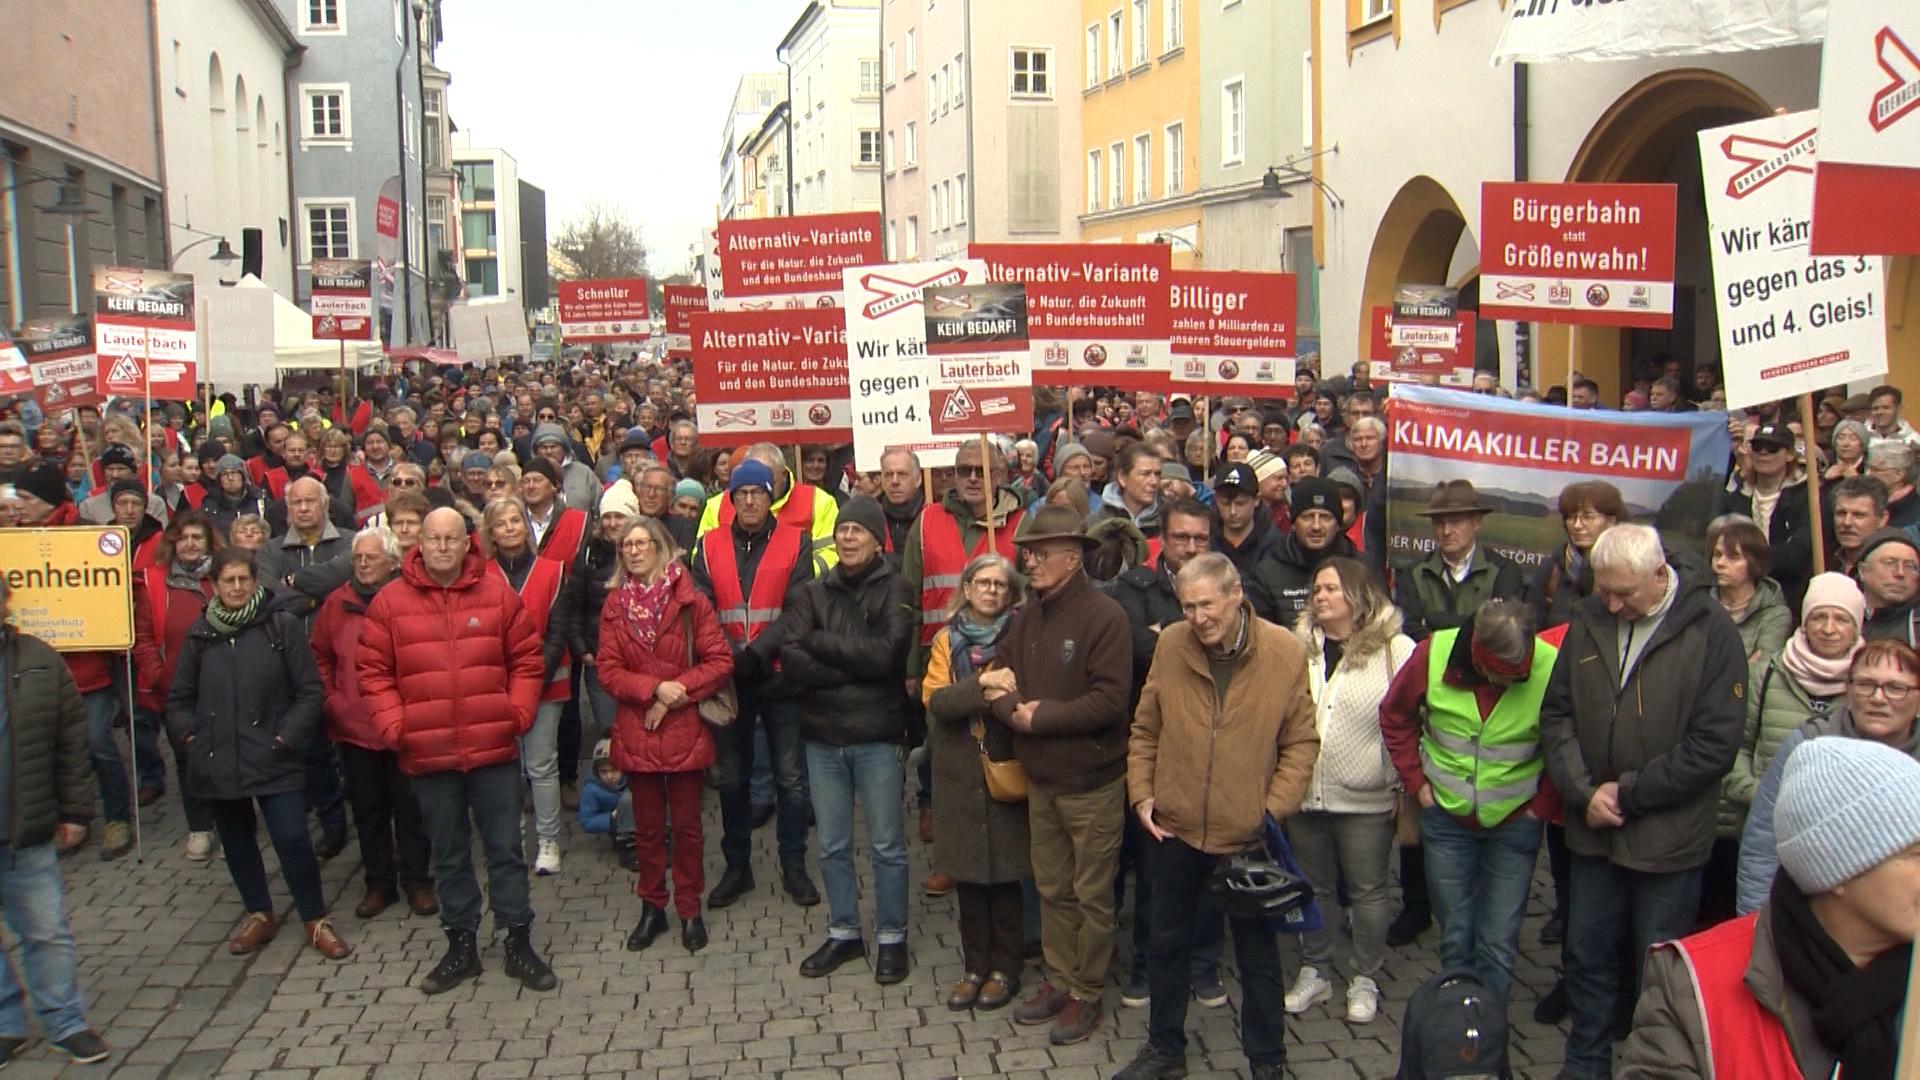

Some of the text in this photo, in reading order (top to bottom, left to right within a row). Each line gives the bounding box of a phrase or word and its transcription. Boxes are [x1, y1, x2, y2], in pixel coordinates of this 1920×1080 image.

[1737, 137, 1817, 190] BRENNERDIALO
[1513, 197, 1640, 228] Bürgerbahn
[728, 228, 873, 251] Alternativ-Variante
[1562, 231, 1586, 242] statt
[1721, 226, 1762, 255] Wir
[741, 259, 757, 271] Für
[760, 257, 775, 271] die
[809, 255, 824, 267] die
[827, 253, 864, 267] Zukunft
[1504, 243, 1648, 272] Größenwahn!
[742, 270, 843, 287] und den Bundeshaus
[984, 261, 1160, 283] Alternativ-Variante
[1727, 255, 1873, 308] gegen das 3.
[576, 287, 630, 300] Schneller
[1026, 295, 1036, 308] ie
[1078, 295, 1097, 309] die
[1101, 295, 1147, 309] Zukunft
[1169, 284, 1248, 316] Billiger
[108, 297, 185, 316] KEIN BEDARF!
[315, 301, 367, 310] Lauterbach
[1400, 304, 1451, 317] KEIN BEDARF!
[937, 319, 1018, 337] KEIN BEDARF!
[1028, 313, 1145, 327] en Bundeshaushalt!
[1172, 318, 1206, 331] zahlen
[1218, 319, 1270, 333] Milliarden
[1273, 321, 1285, 333] zu
[1732, 293, 1874, 346] und 4. Gleis!
[702, 324, 848, 349] Alternativ-Varia
[1170, 333, 1287, 350] unseren Steuergeldern
[1400, 328, 1450, 342] Lauterbach
[856, 339, 890, 360] Wir
[39, 360, 93, 379] Lauterbach
[717, 360, 737, 374] Für
[741, 359, 759, 373] die
[801, 358, 819, 371] die
[822, 356, 849, 371] Zuku
[939, 360, 1020, 379] Lauterbach
[719, 377, 741, 391] und
[744, 376, 766, 390] den
[859, 374, 920, 398] gegen
[862, 404, 922, 427] und 4.
[1393, 420, 1679, 472] KLIMAKILLER BAHN
[6, 560, 121, 588] enheim
